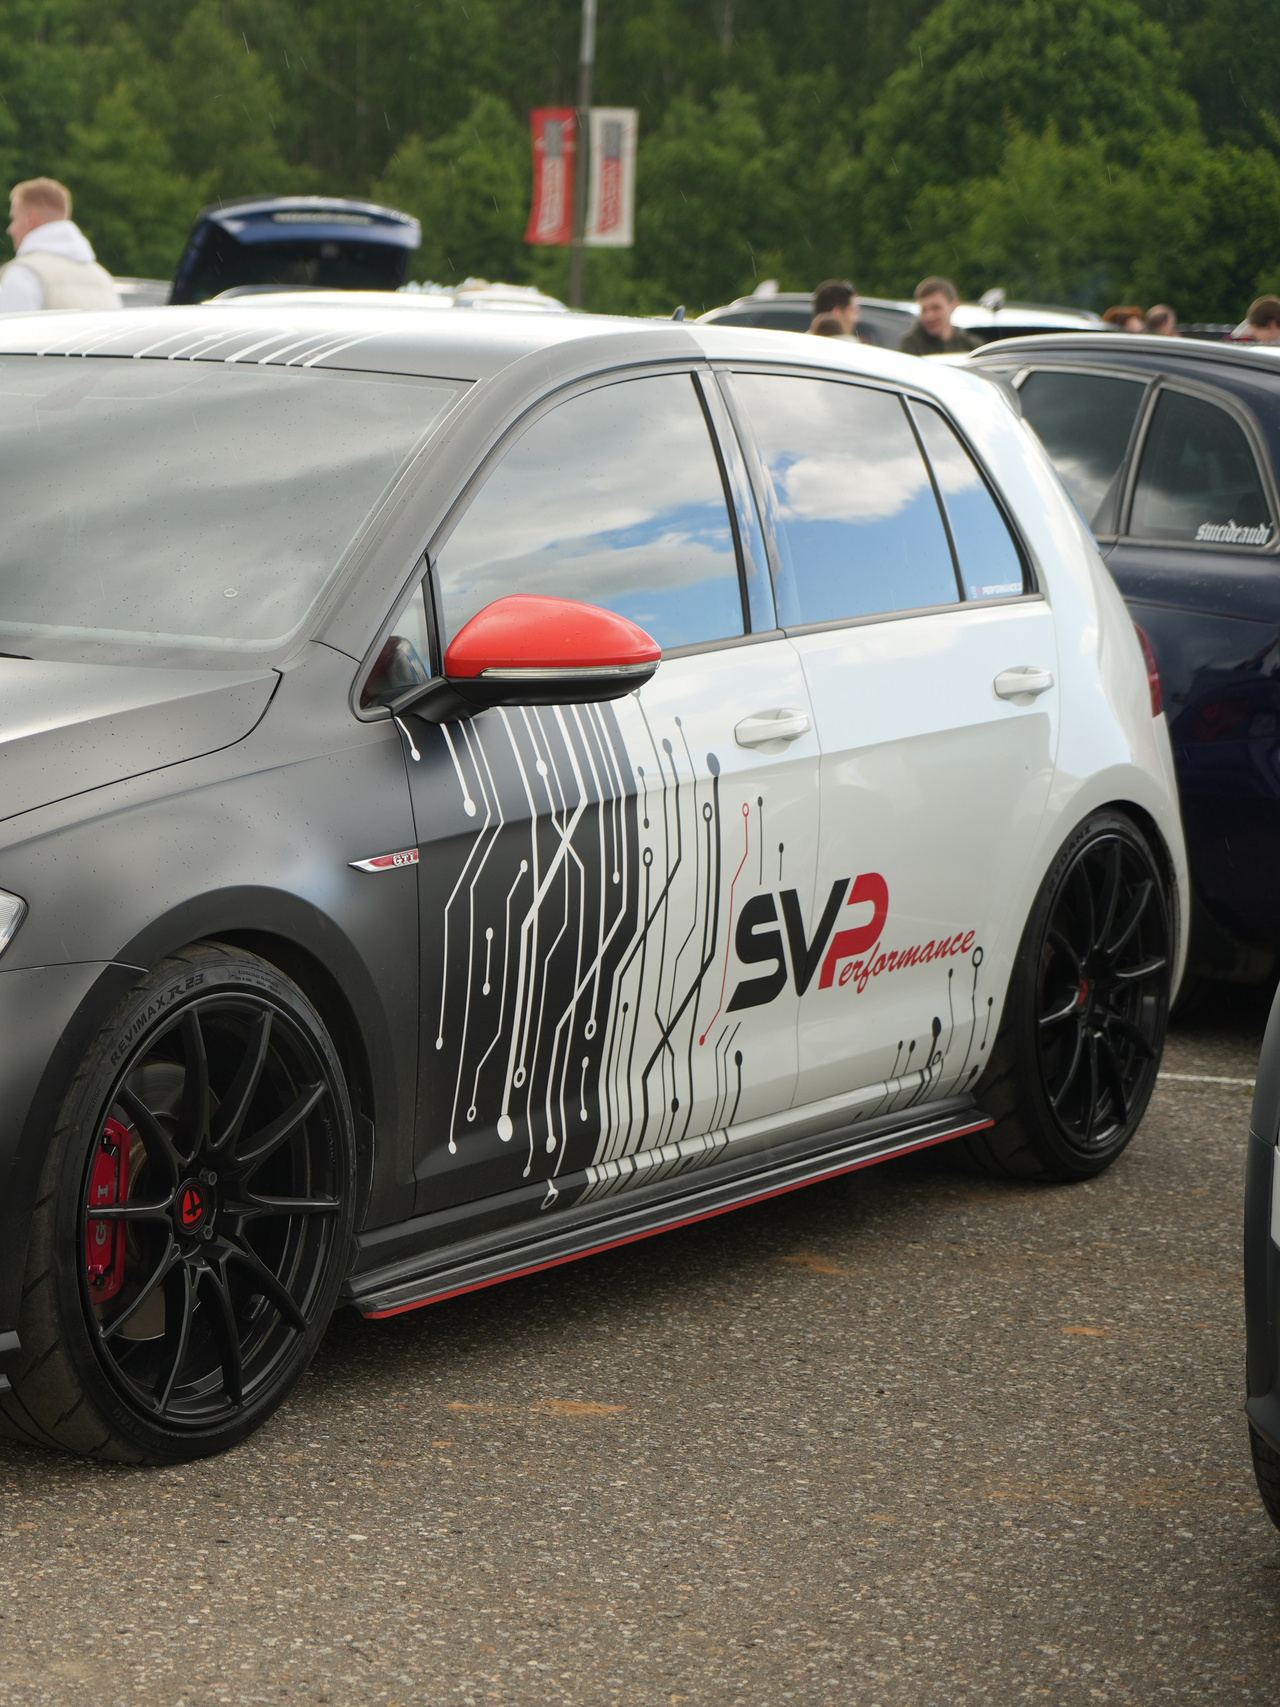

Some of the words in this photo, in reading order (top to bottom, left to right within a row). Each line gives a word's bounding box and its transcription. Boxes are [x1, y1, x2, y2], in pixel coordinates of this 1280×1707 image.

[392, 852, 415, 867] GTI
[110, 994, 166, 1067] REVIMAX
[95, 1184, 109, 1245] GI
